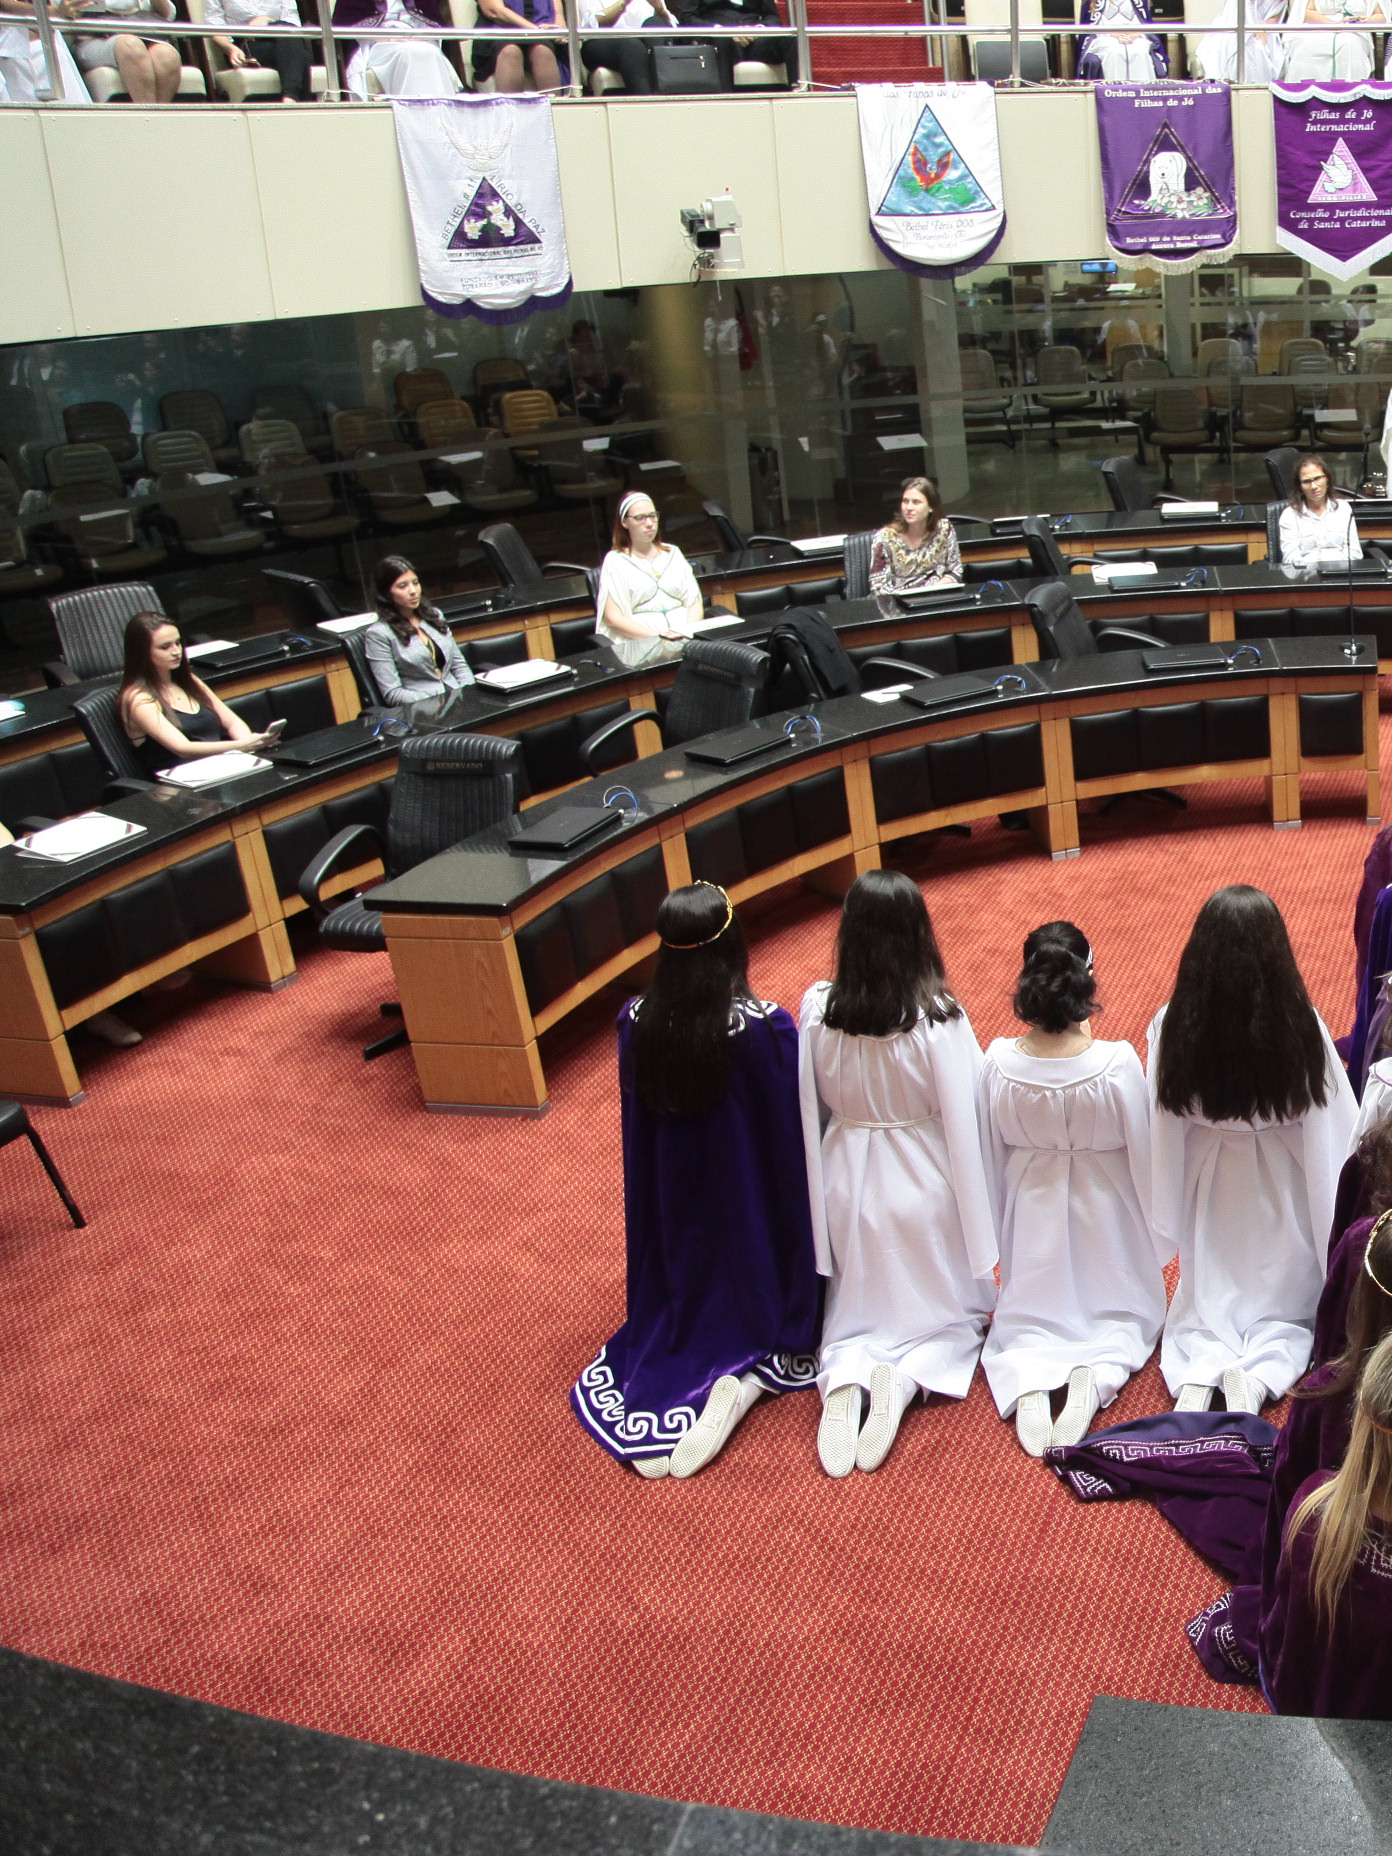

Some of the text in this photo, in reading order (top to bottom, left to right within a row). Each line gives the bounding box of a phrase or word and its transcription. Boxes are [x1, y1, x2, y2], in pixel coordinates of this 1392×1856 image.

[1104, 86, 1222, 97] Ordem Internacional das
[1134, 97, 1194, 108] Filhas de Jó
[1308, 109, 1373, 121] Filhas de Jó
[1305, 121, 1377, 132] Internacional
[1290, 208, 1330, 219] Conselho
[442, 202, 468, 241] BETHEL
[514, 203, 527, 218] DA
[528, 218, 546, 237] PAZ
[1298, 219, 1387, 229] de Santa Catarina
[435, 762, 483, 770] RESERVADO
